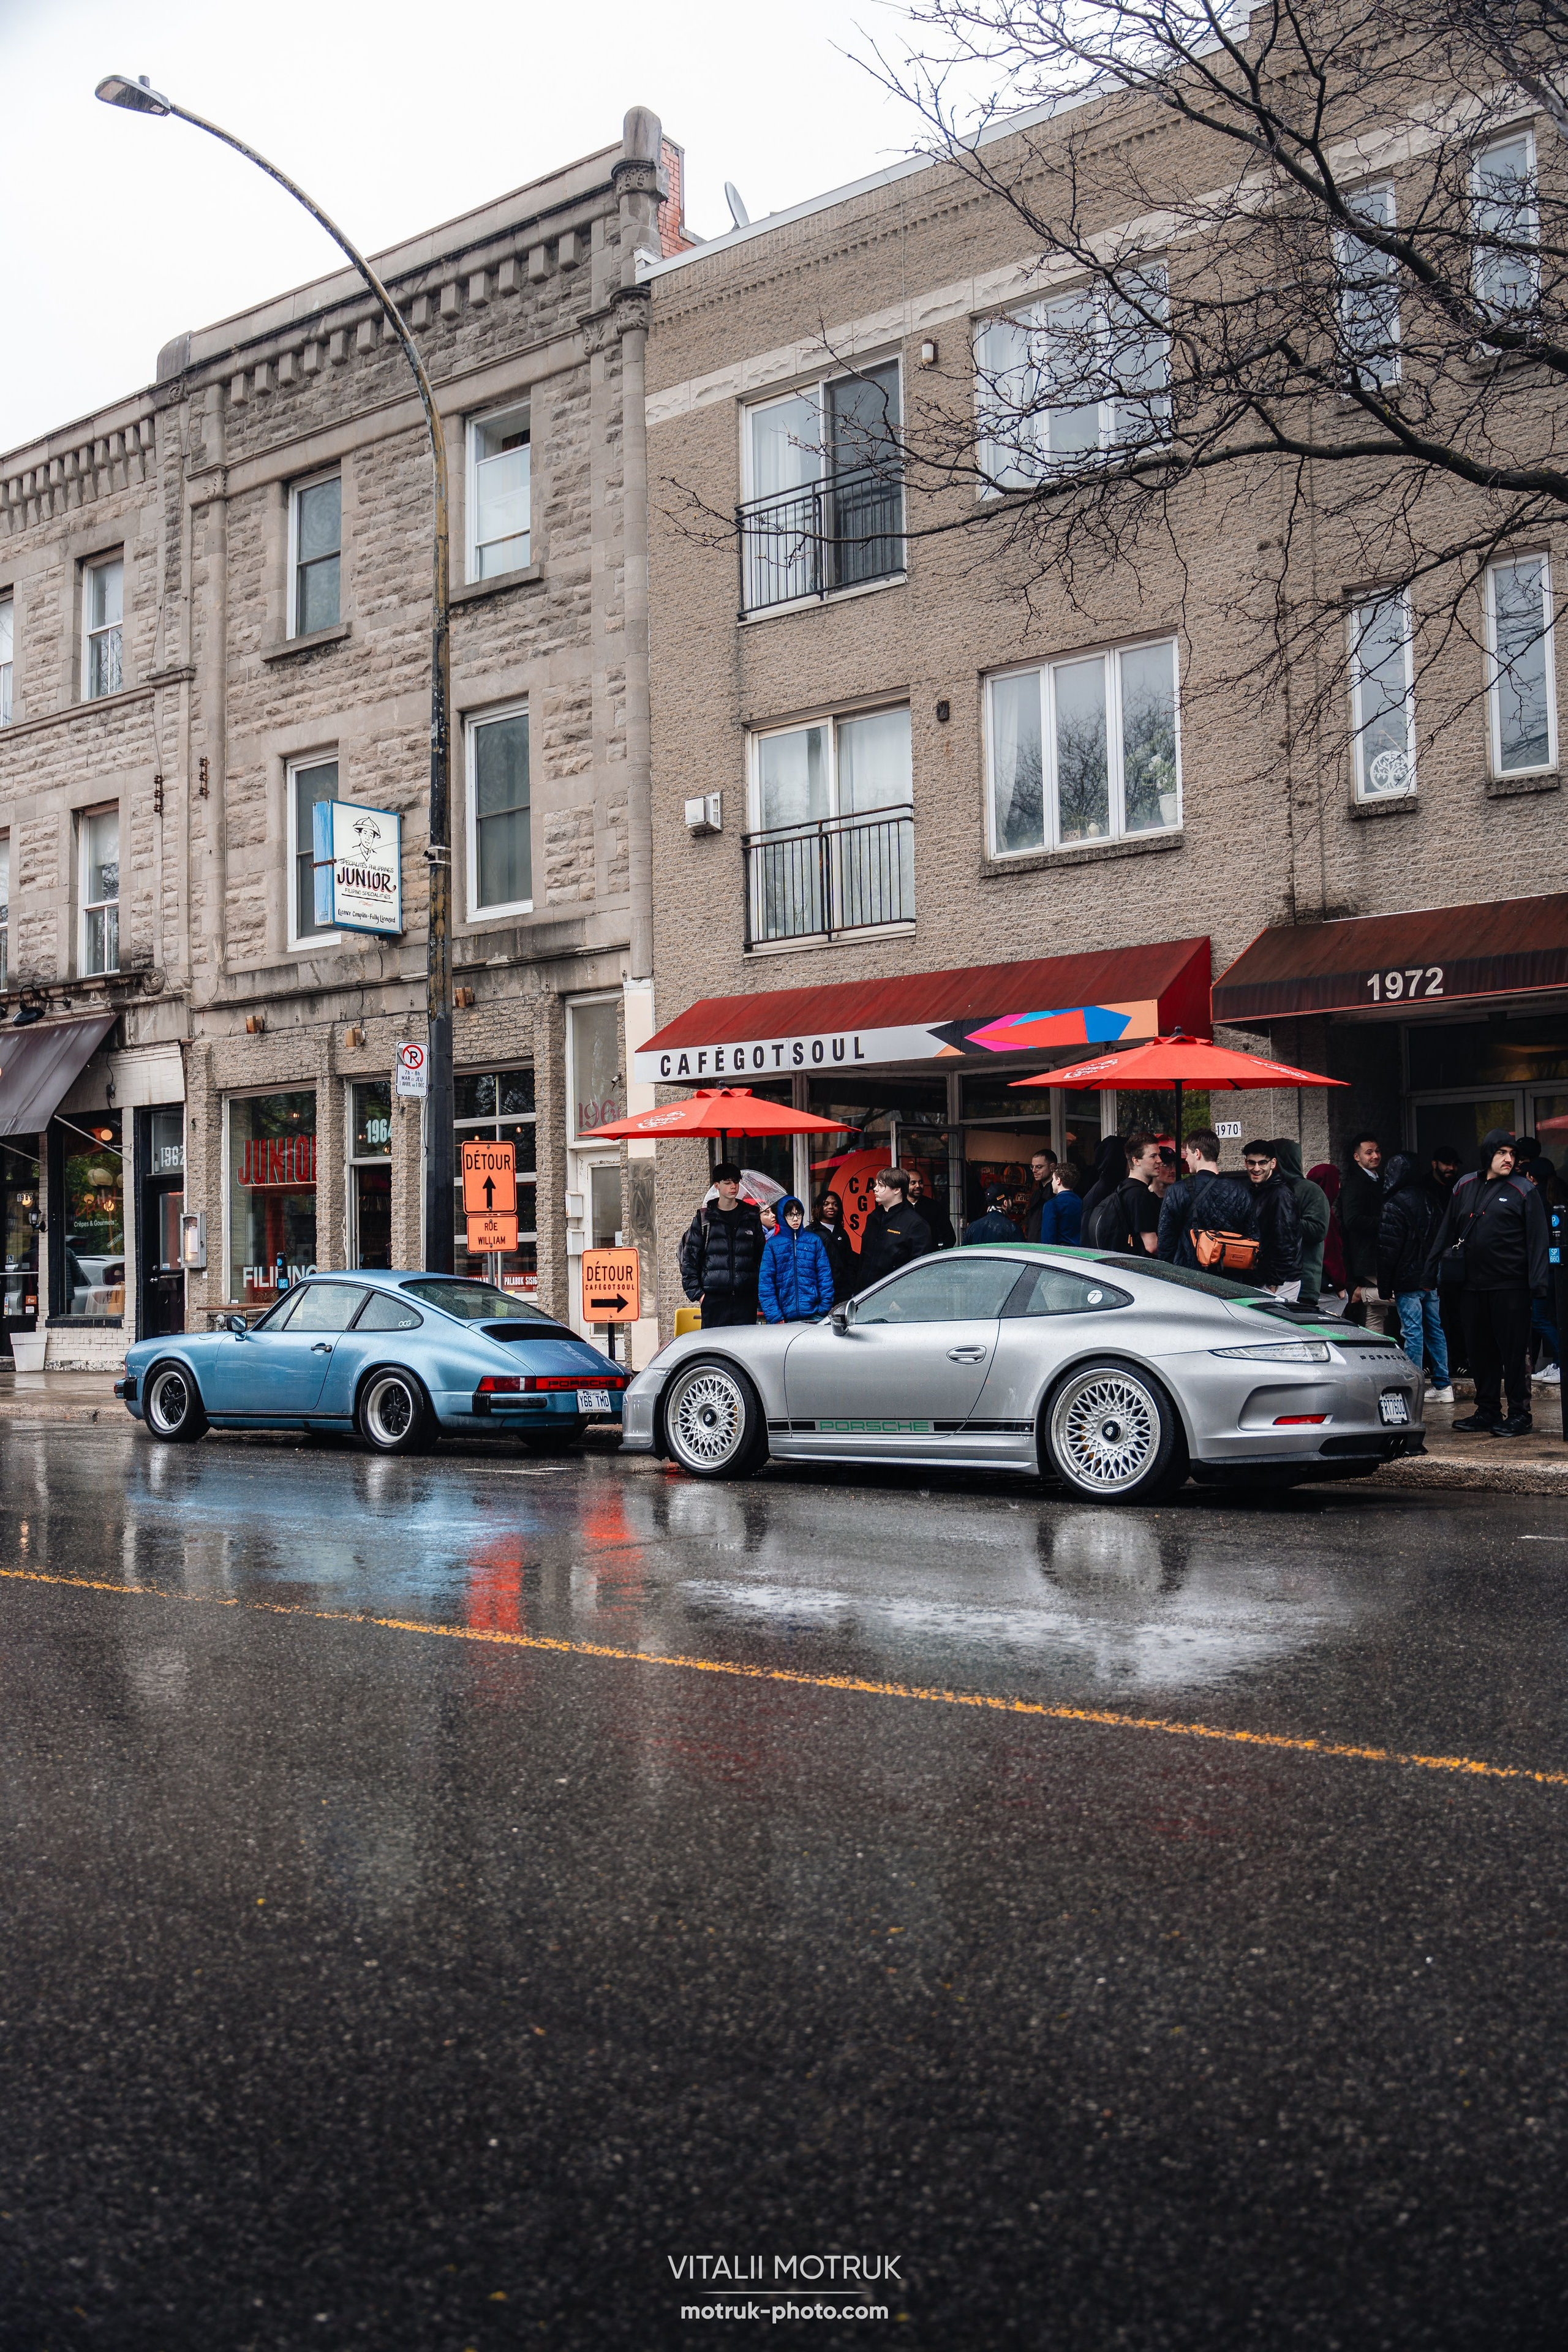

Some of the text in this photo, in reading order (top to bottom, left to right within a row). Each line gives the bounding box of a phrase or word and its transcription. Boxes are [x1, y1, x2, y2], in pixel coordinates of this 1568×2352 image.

[369, 864, 394, 873] PHILIPPINES
[336, 867, 397, 893] JUNIOR
[362, 891, 391, 900] SPECIALITIES
[1367, 967, 1444, 1001] 1972
[660, 1036, 865, 1077] CAFÉGOTSOUL
[578, 1099, 620, 1129] 196
[1217, 1124, 1238, 1136] 1970
[466, 1150, 511, 1170] DÉTOUR
[17, 1193, 33, 1202] 1960
[484, 1223, 498, 1231] RUE
[478, 1235, 506, 1245] WILLIAM
[587, 1261, 633, 1281] DÉTOUR
[504, 1276, 524, 1286] PALABOK
[526, 1276, 537, 1286] SISIG
[579, 1395, 609, 1408] Y66 TMD
[820, 1421, 929, 1431] PORSCHE
